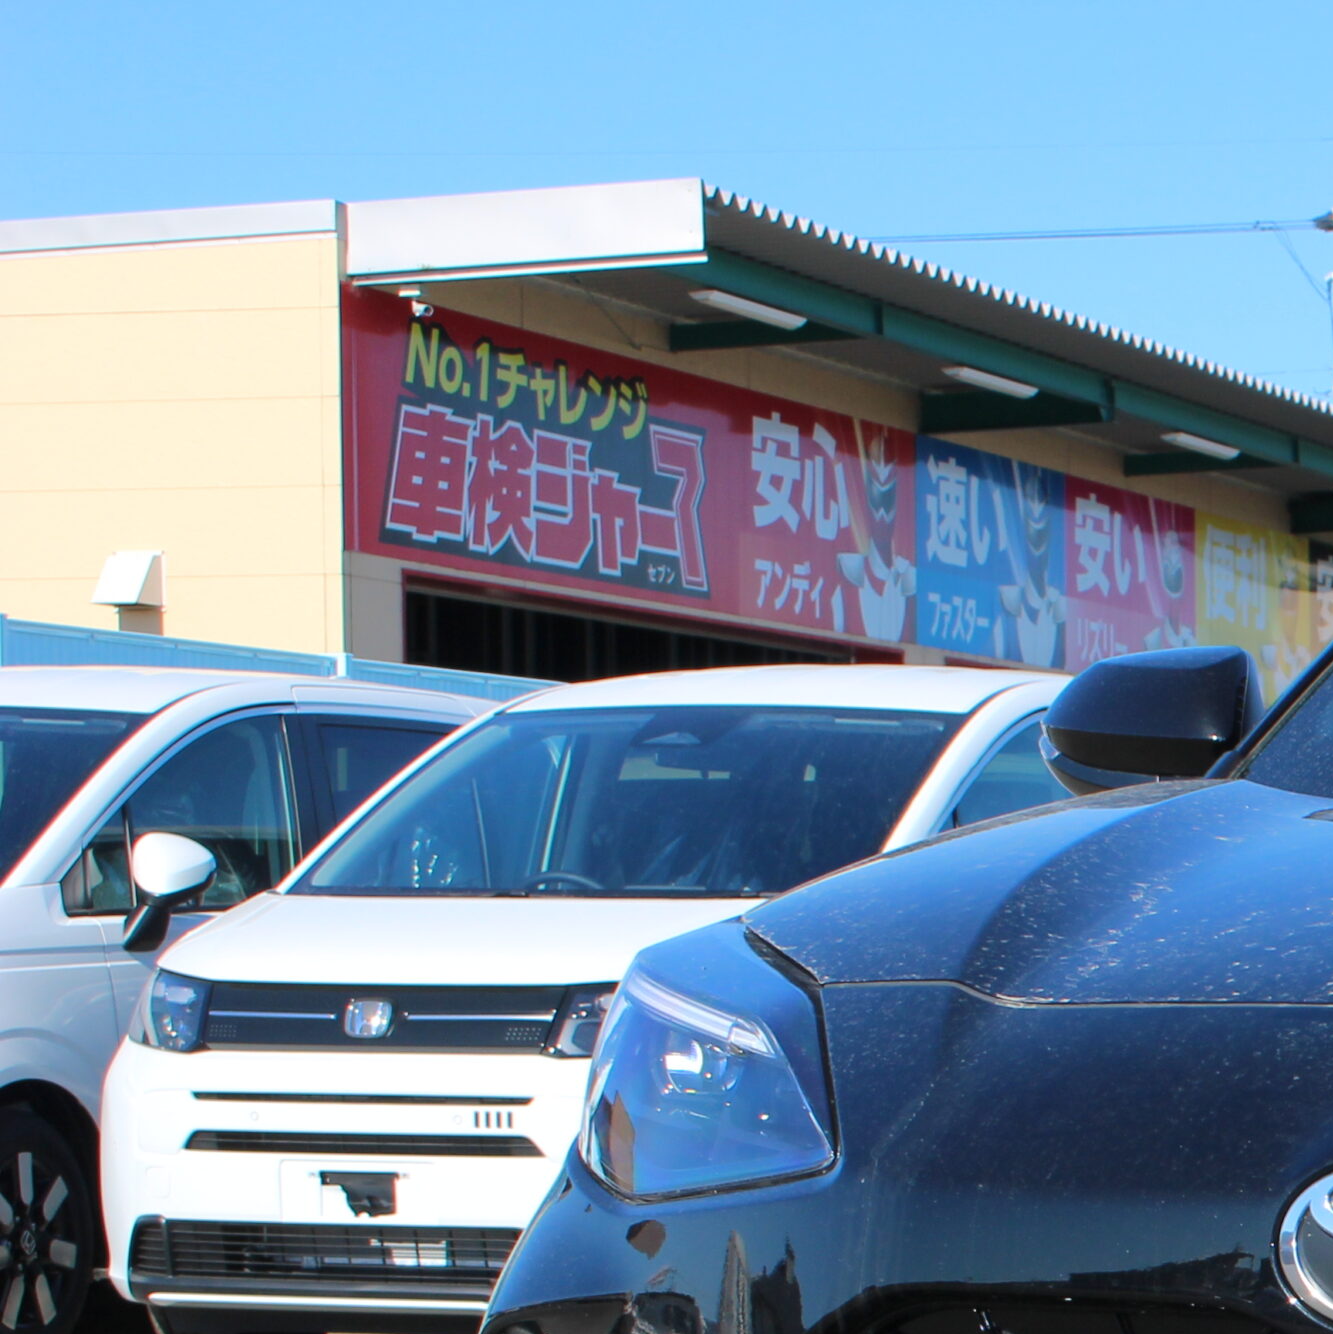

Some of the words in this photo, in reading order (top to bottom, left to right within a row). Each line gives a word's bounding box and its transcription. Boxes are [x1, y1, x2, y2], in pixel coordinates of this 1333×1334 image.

[405, 322, 649, 440] No.1チャレンジ
[751, 412, 850, 541] 安心
[926, 454, 1007, 568] 速い
[647, 563, 676, 586] セブン
[1074, 493, 1147, 597] 安い
[1203, 524, 1268, 631] 便利
[928, 592, 989, 643] ファスター
